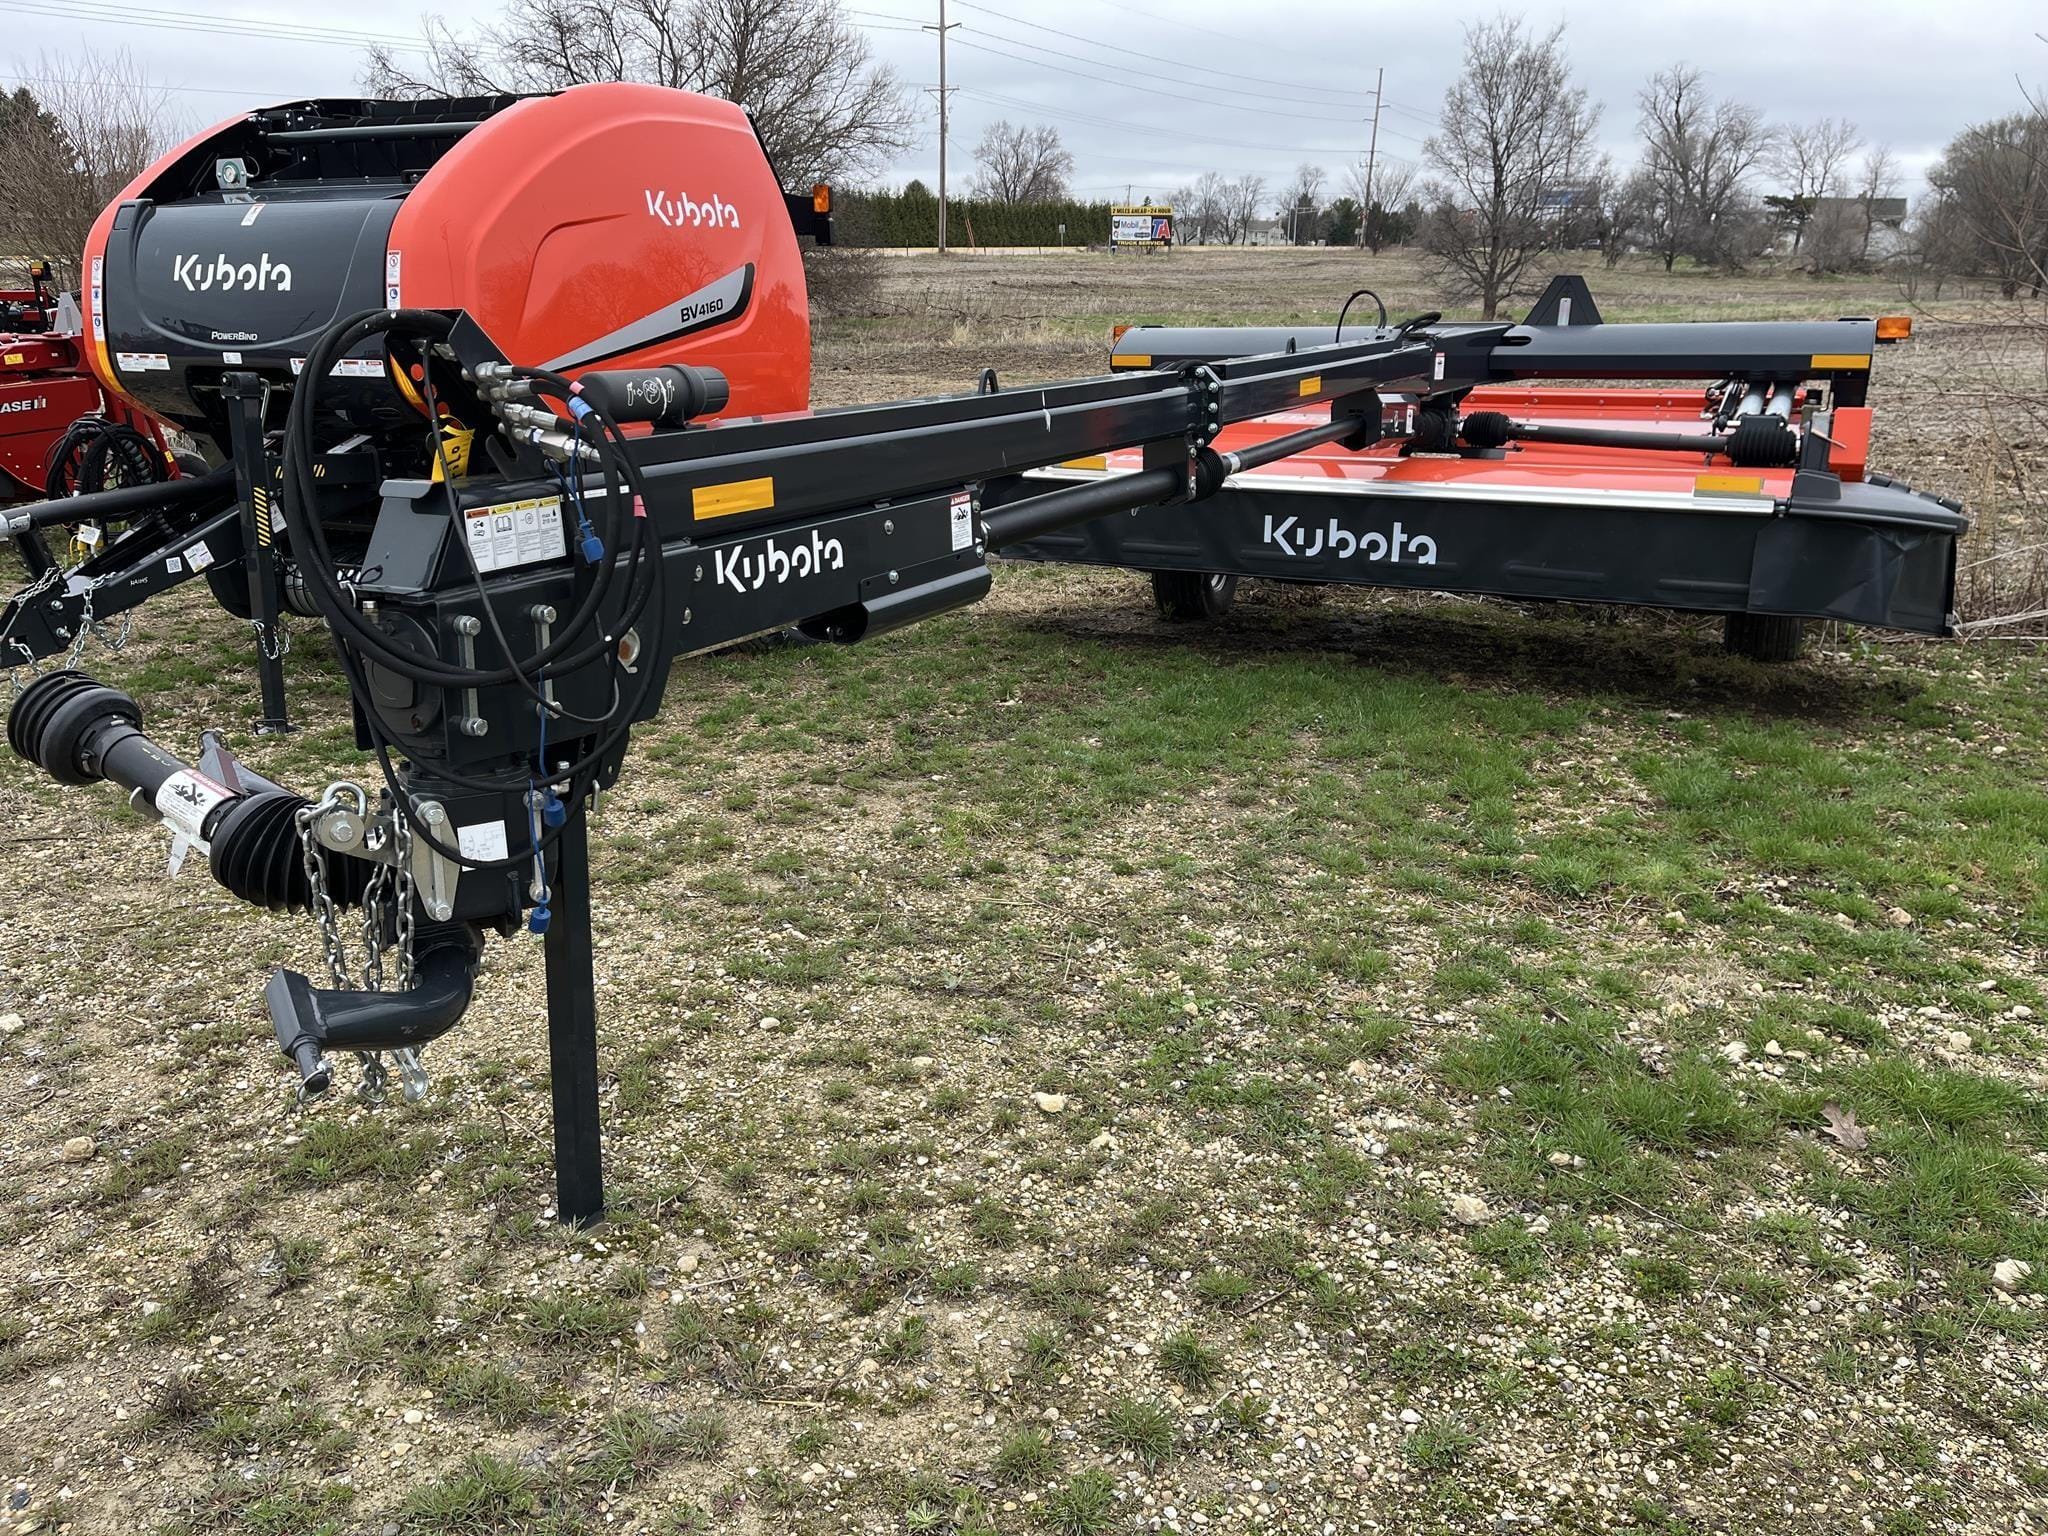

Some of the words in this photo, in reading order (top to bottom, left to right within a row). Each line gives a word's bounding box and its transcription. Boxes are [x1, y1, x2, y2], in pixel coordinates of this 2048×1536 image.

[644, 189, 740, 228] Kubota
[1121, 220, 1139, 229] Mobil
[1152, 219, 1171, 238] TA
[173, 252, 292, 292] Kubota
[680, 298, 724, 323] BV4160
[0, 400, 32, 414] ASE
[1263, 514, 1438, 565] Kubota
[714, 529, 844, 593] Kubota
